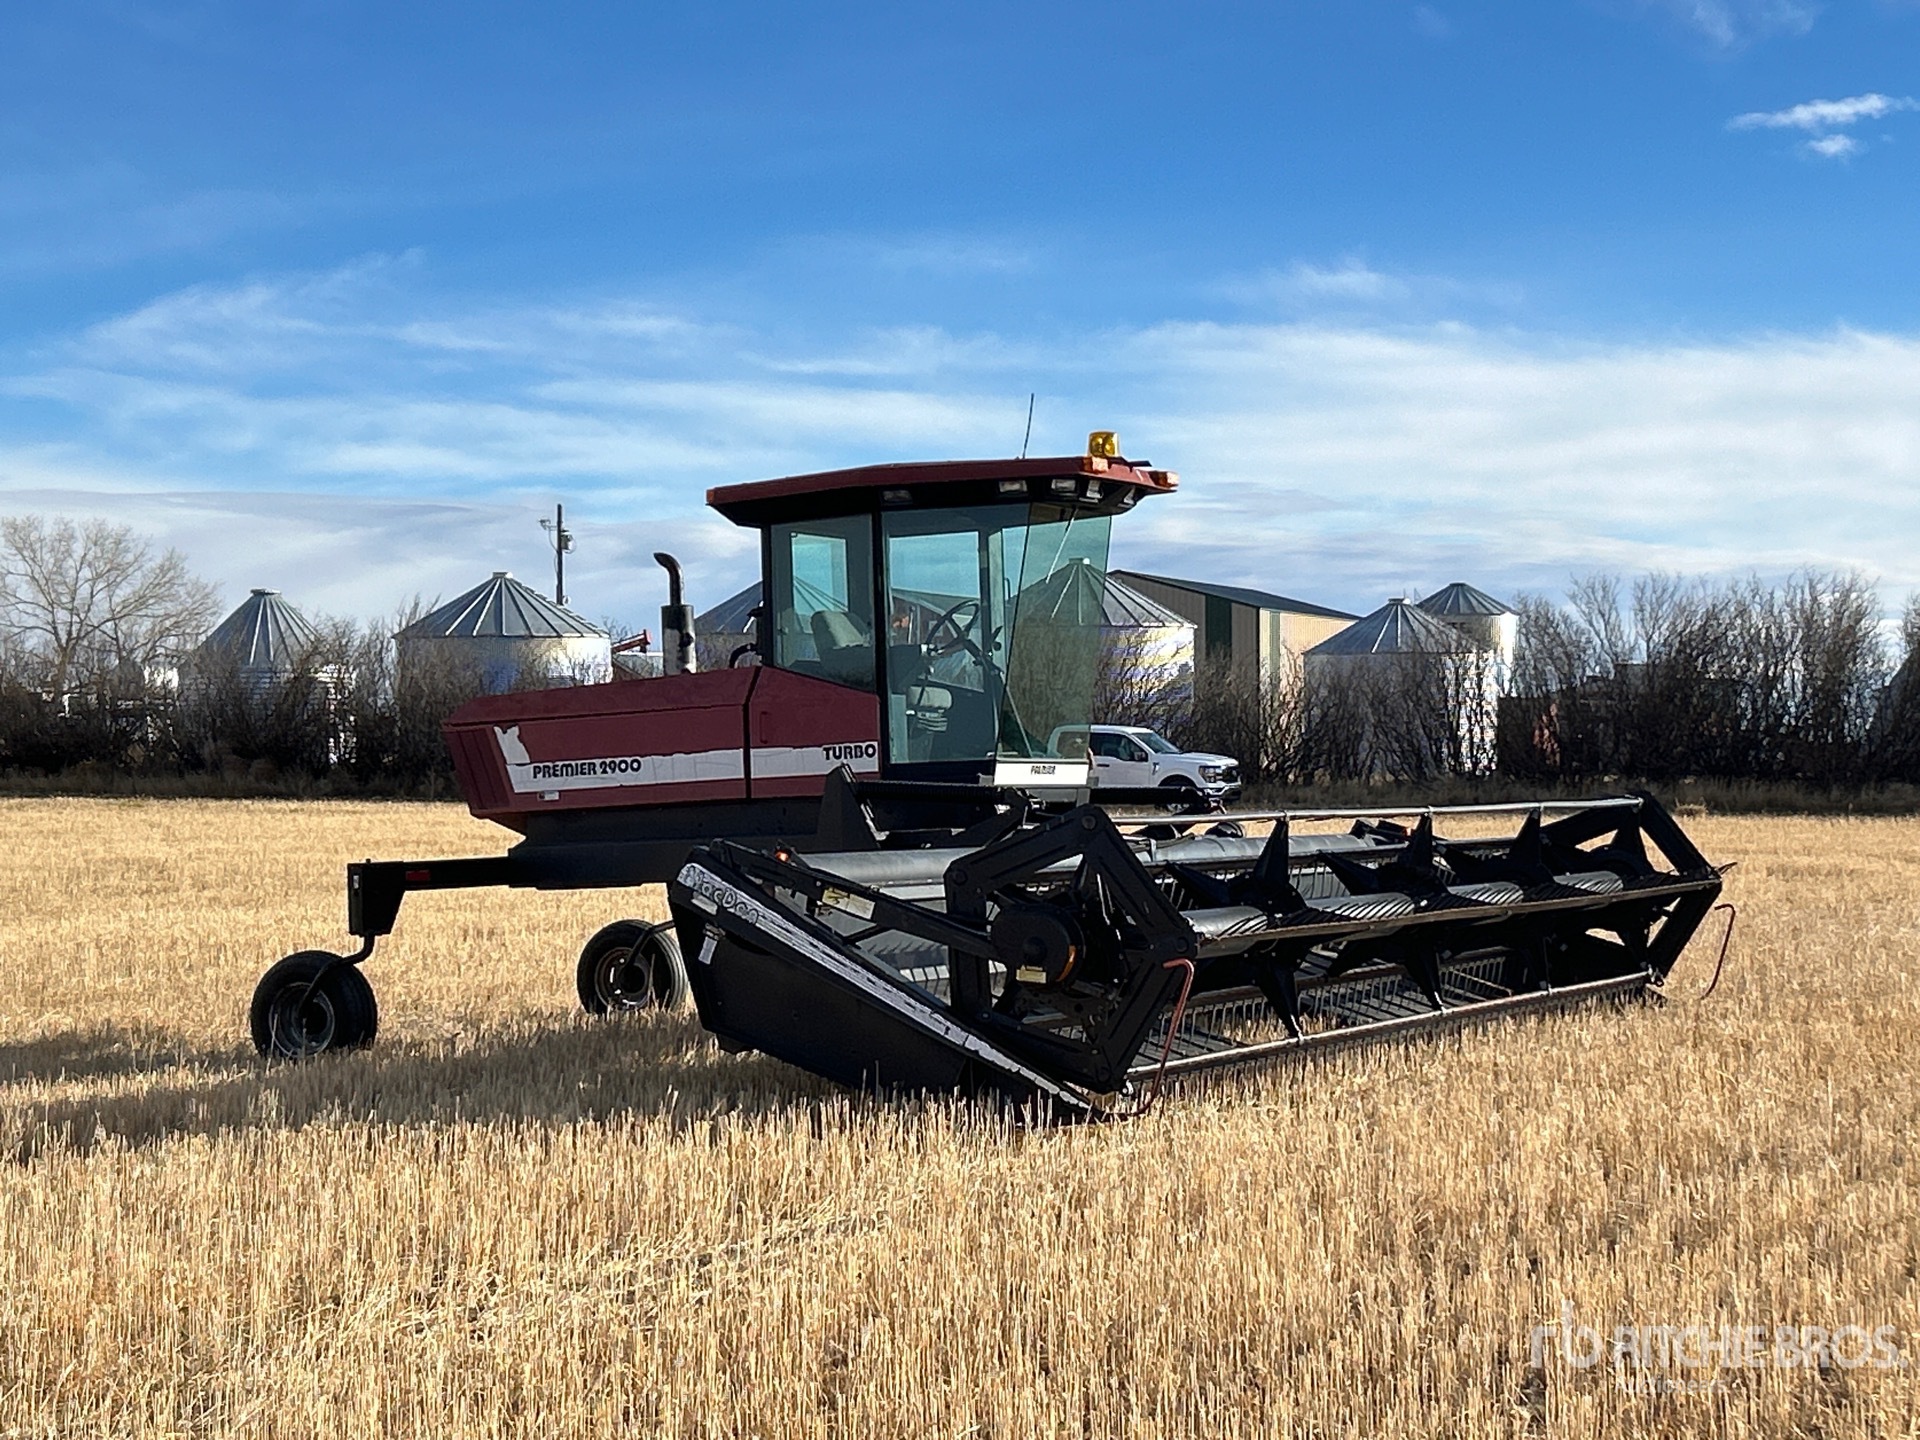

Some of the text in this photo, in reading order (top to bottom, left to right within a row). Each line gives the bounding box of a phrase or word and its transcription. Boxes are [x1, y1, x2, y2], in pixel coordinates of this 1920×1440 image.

[822, 743, 877, 761] TURBO
[533, 759, 642, 779] PREMIER 2900
